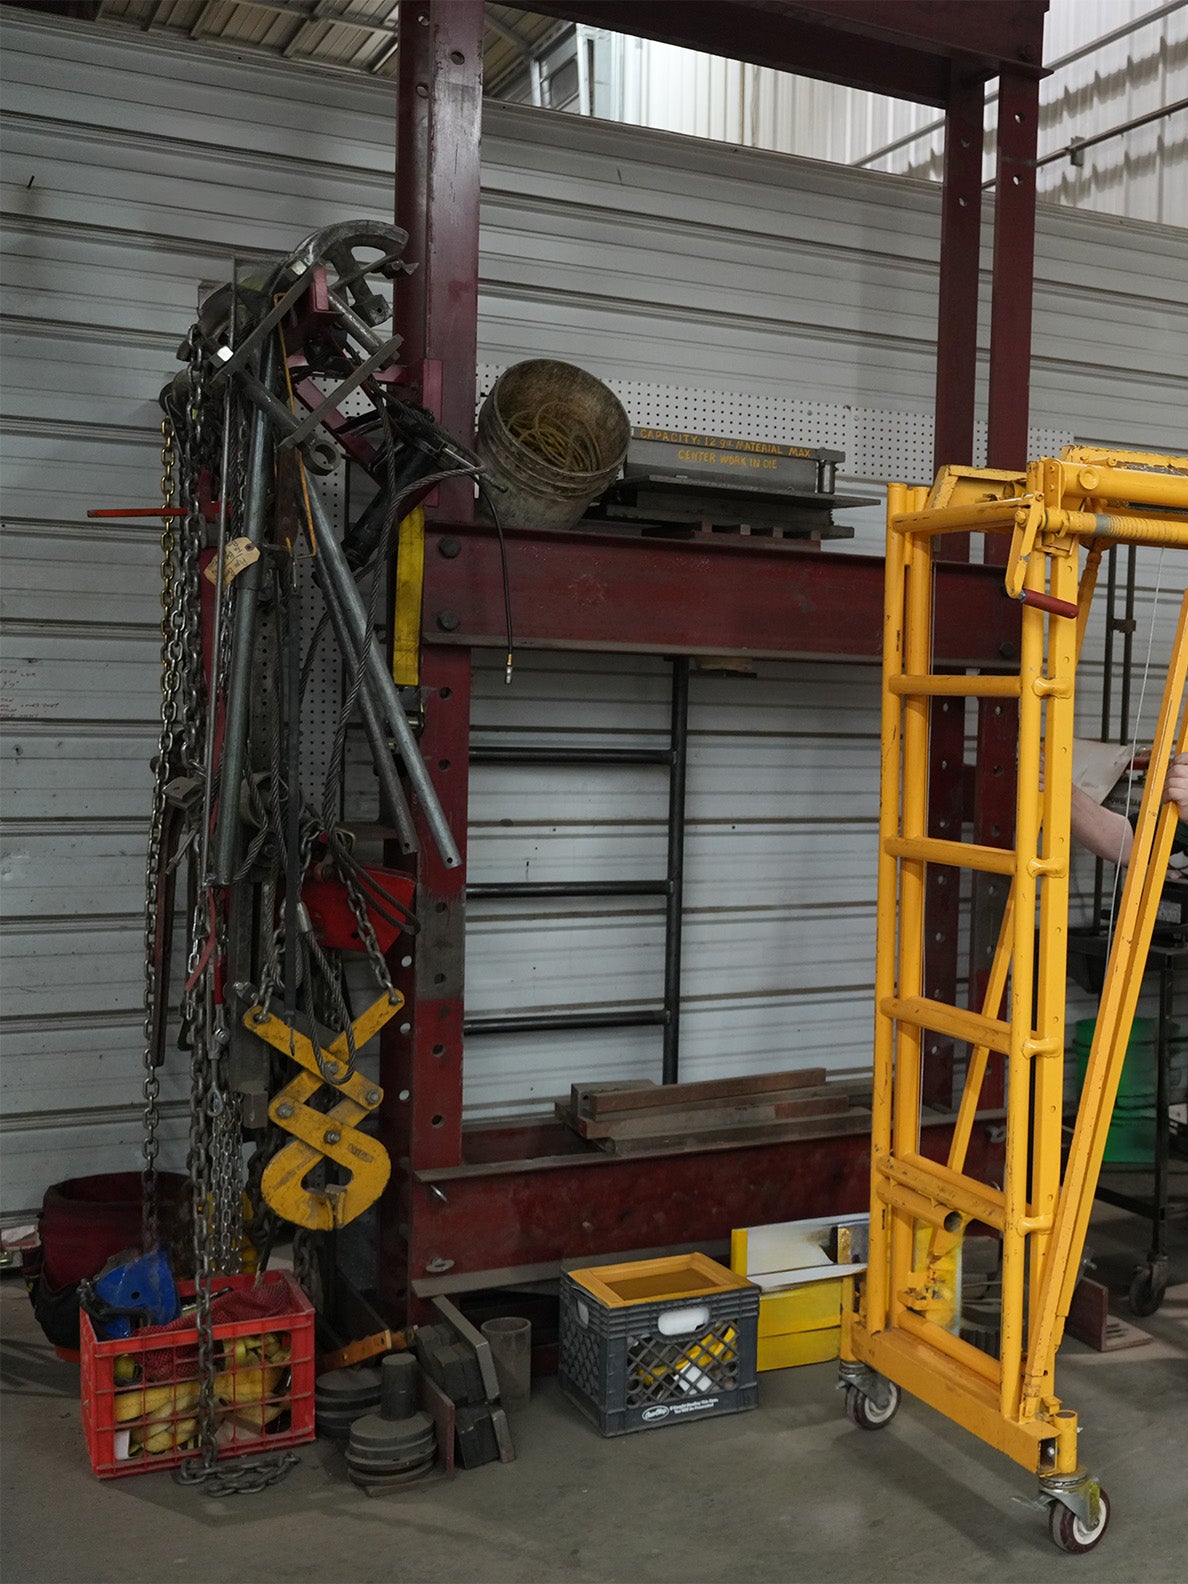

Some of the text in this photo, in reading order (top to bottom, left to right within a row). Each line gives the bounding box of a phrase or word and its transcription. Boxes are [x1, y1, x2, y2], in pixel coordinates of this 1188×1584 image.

[704, 436, 716, 446] 12
[735, 441, 783, 454] MATERIAL
[678, 449, 777, 469] CENTER WORK IN DIE
